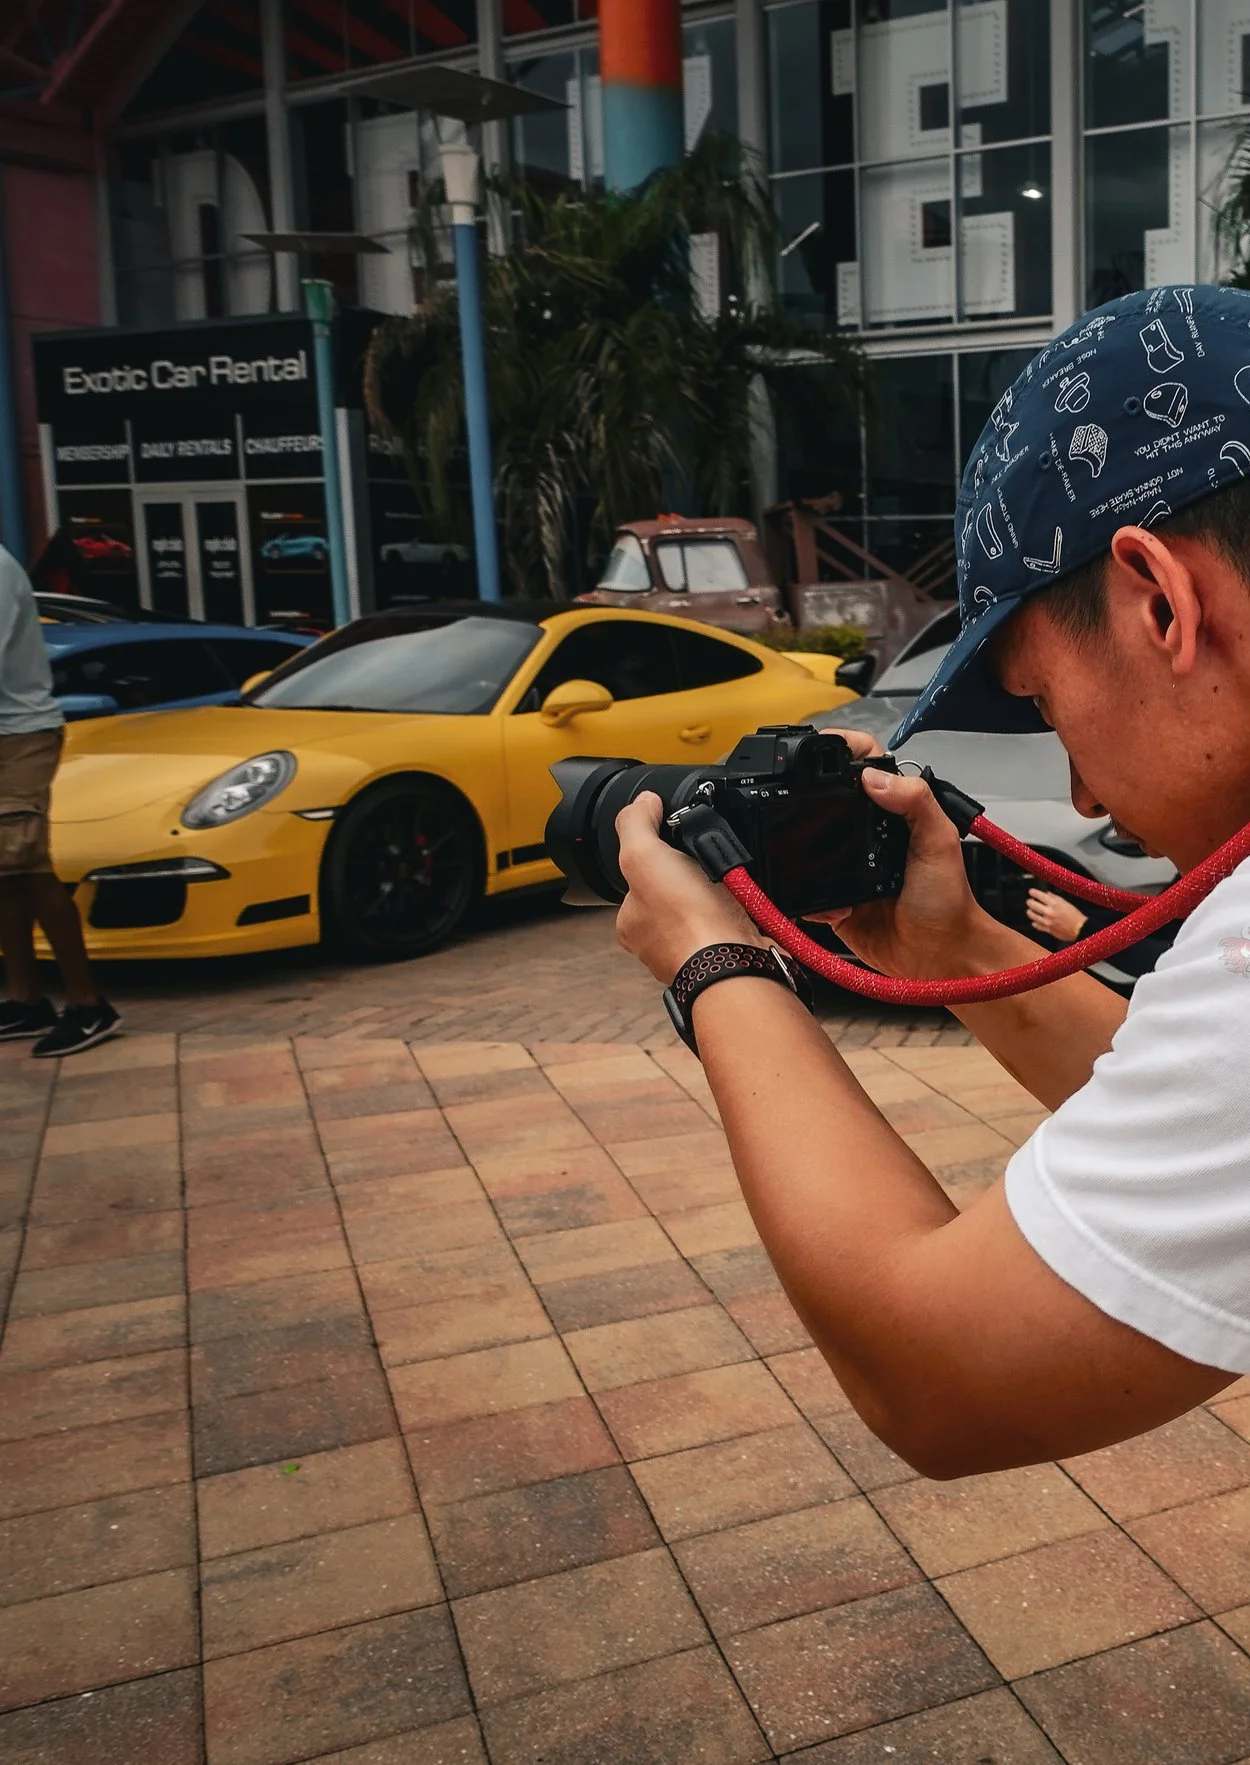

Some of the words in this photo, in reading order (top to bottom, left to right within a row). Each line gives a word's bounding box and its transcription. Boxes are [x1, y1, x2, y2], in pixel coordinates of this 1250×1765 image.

[63, 365, 148, 394] Exotic
[150, 360, 207, 389] Car
[209, 350, 307, 384] Rental
[1134, 444, 1151, 456] YOU
[1183, 419, 1209, 436] WANT
[1213, 414, 1226, 423] TO
[1145, 448, 1159, 460] HIT
[1162, 440, 1183, 453] THIS
[1184, 423, 1221, 445] ANYWAY
[140, 442, 174, 459] DAILY
[176, 438, 232, 457] RENTALS
[1166, 466, 1184, 481] NOT
[1133, 475, 1164, 495] GONNA
[1108, 488, 1134, 508] SKATE
[1089, 501, 1109, 519] HERE
